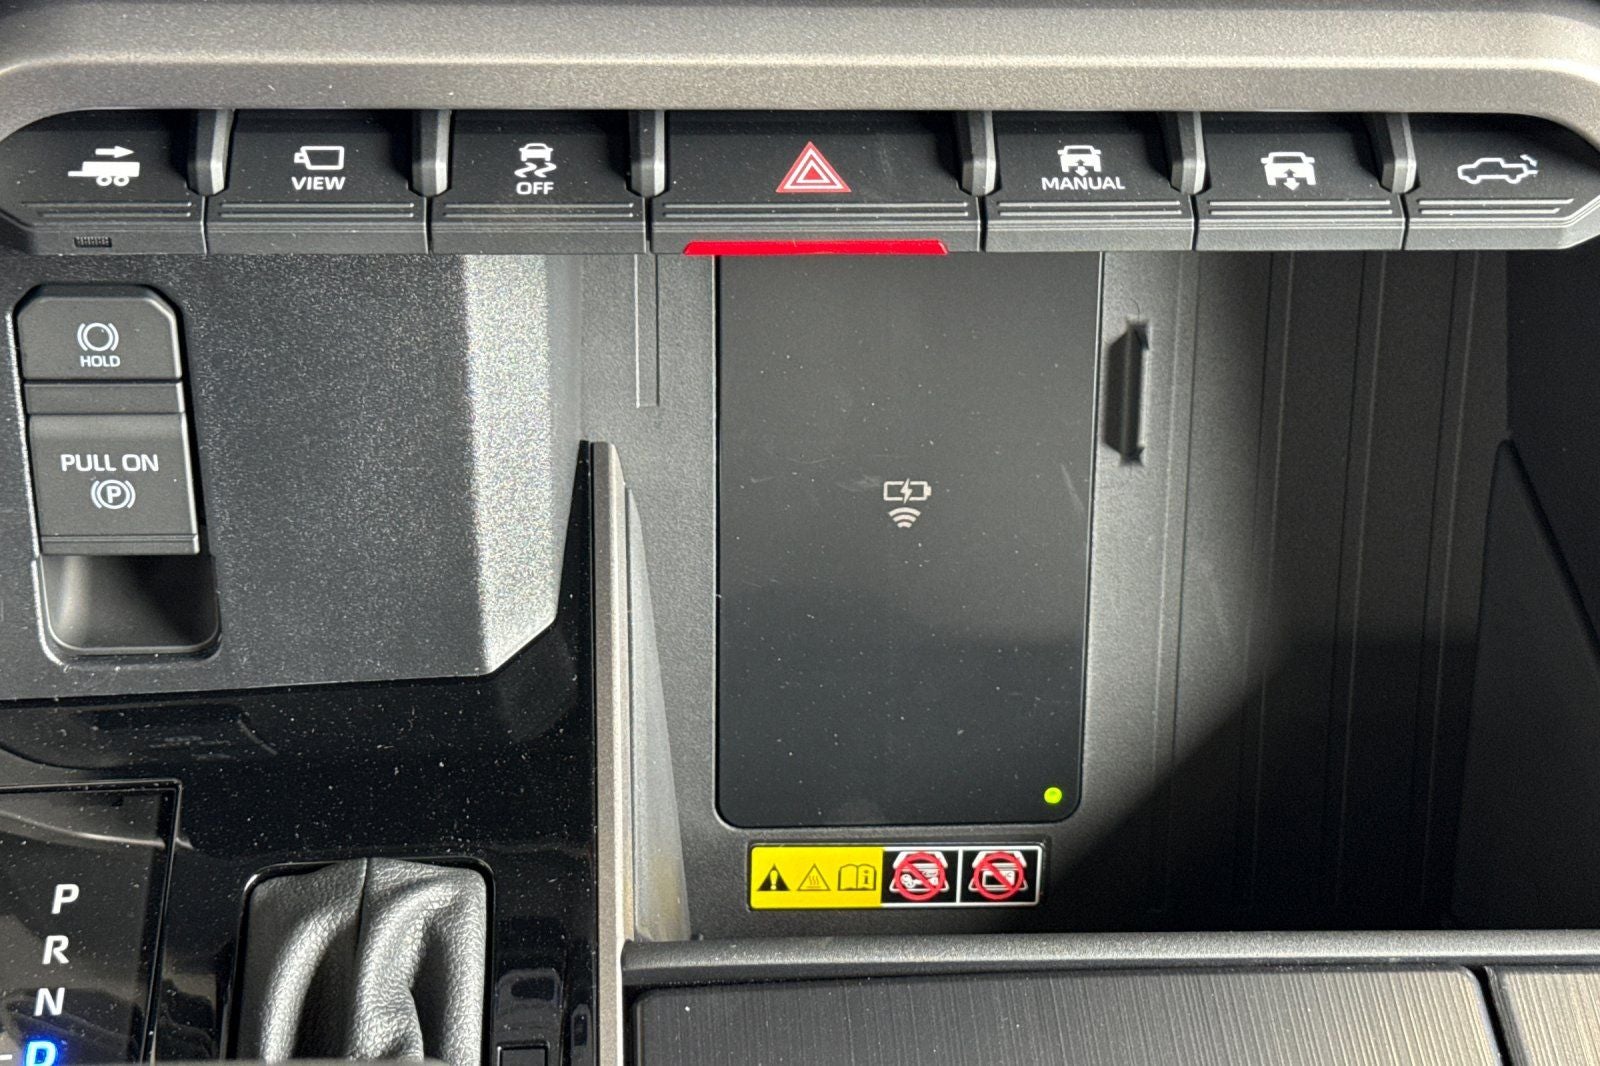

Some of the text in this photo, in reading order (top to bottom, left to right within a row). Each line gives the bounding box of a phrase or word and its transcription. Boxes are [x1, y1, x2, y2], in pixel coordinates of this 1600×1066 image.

[291, 176, 346, 191] VIEW
[515, 181, 554, 195] OFF
[1041, 176, 1126, 190] MANUAL
[80, 355, 121, 368] HOLD
[60, 453, 159, 472] PULL ON
[51, 883, 80, 915] P
[41, 934, 70, 965] R
[33, 987, 66, 1017] N
[25, 1041, 57, 1066] D
